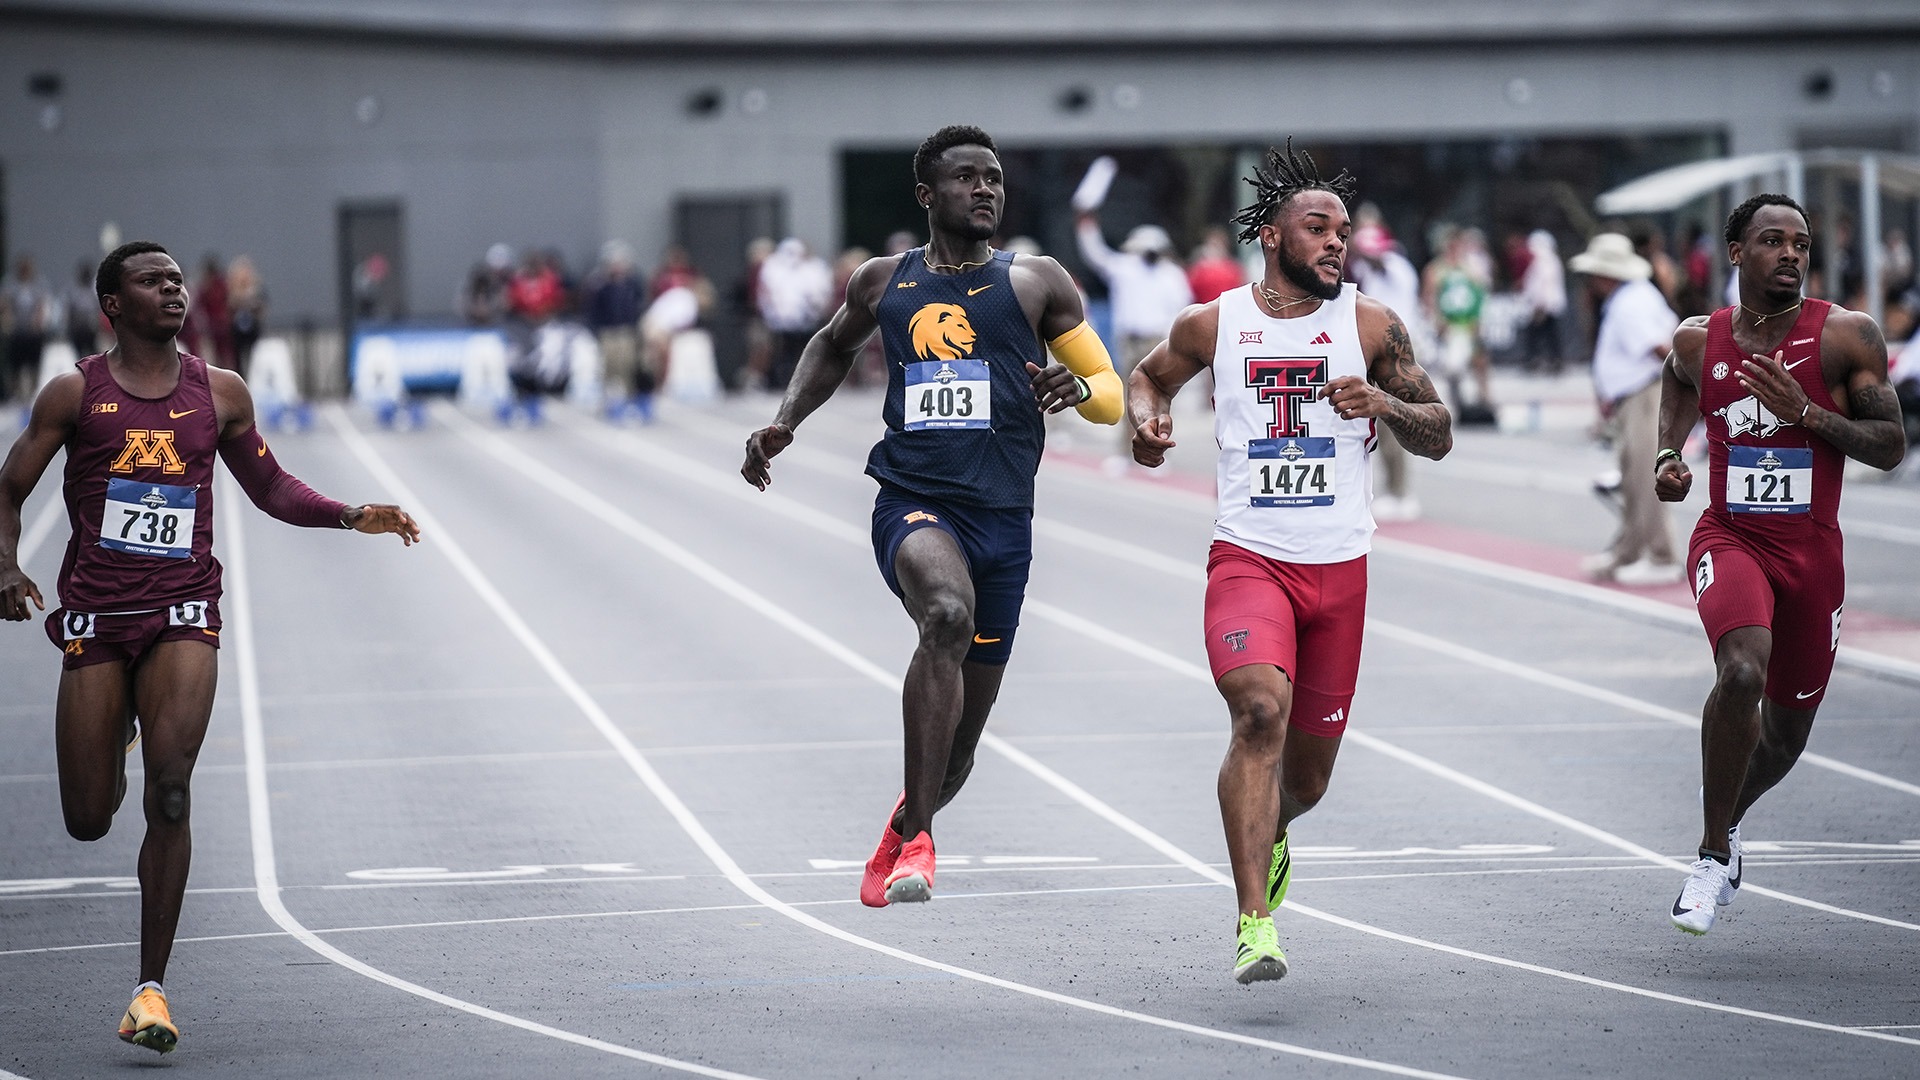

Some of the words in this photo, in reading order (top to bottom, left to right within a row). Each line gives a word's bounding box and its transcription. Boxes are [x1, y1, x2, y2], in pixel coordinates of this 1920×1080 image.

[919, 387, 973, 417] 403
[109, 429, 186, 475] M
[1260, 464, 1327, 494] 1474
[1744, 474, 1794, 502] 121
[120, 509, 178, 545] 738
